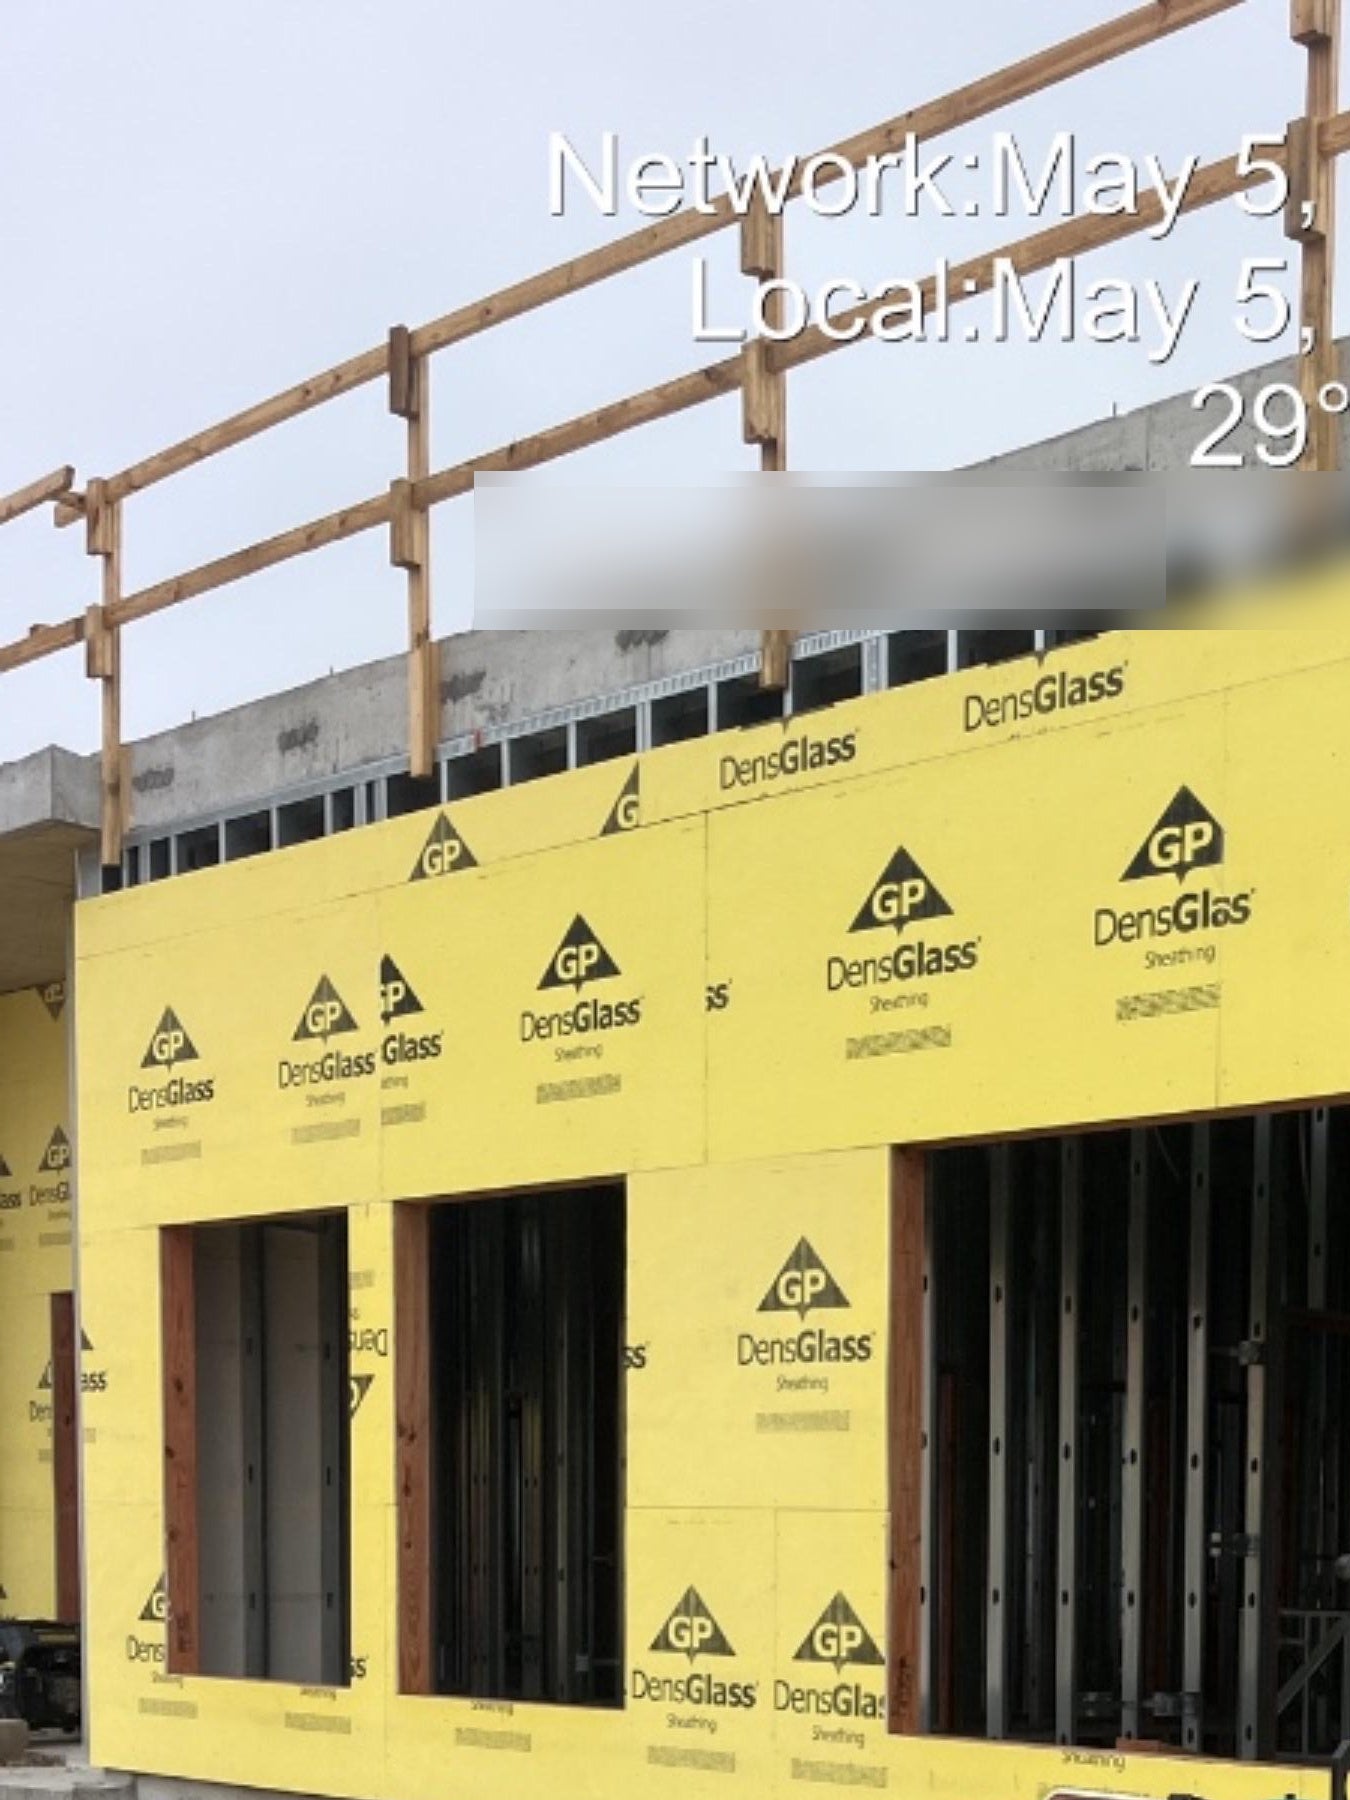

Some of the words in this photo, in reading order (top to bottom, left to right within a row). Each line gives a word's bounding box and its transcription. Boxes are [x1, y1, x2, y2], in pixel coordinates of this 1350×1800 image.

[965, 664, 1126, 732] DensGlass
[720, 731, 857, 789] DensGlass
[422, 838, 461, 875] GP
[1147, 821, 1213, 869] GP
[871, 877, 926, 921] GP
[555, 942, 599, 981] GP
[827, 940, 978, 991] DensGlass
[305, 1001, 342, 1034] GP
[520, 998, 642, 1042] DensGlass
[152, 1031, 184, 1061] GP
[278, 1052, 375, 1090] DensGlass
[128, 1078, 214, 1114] DensGlass
[776, 1268, 827, 1306] GP
[737, 1330, 872, 1366] DensGlass
[668, 1616, 714, 1649] GP
[812, 1621, 864, 1659] GP
[632, 1671, 756, 1708] DensGlass
